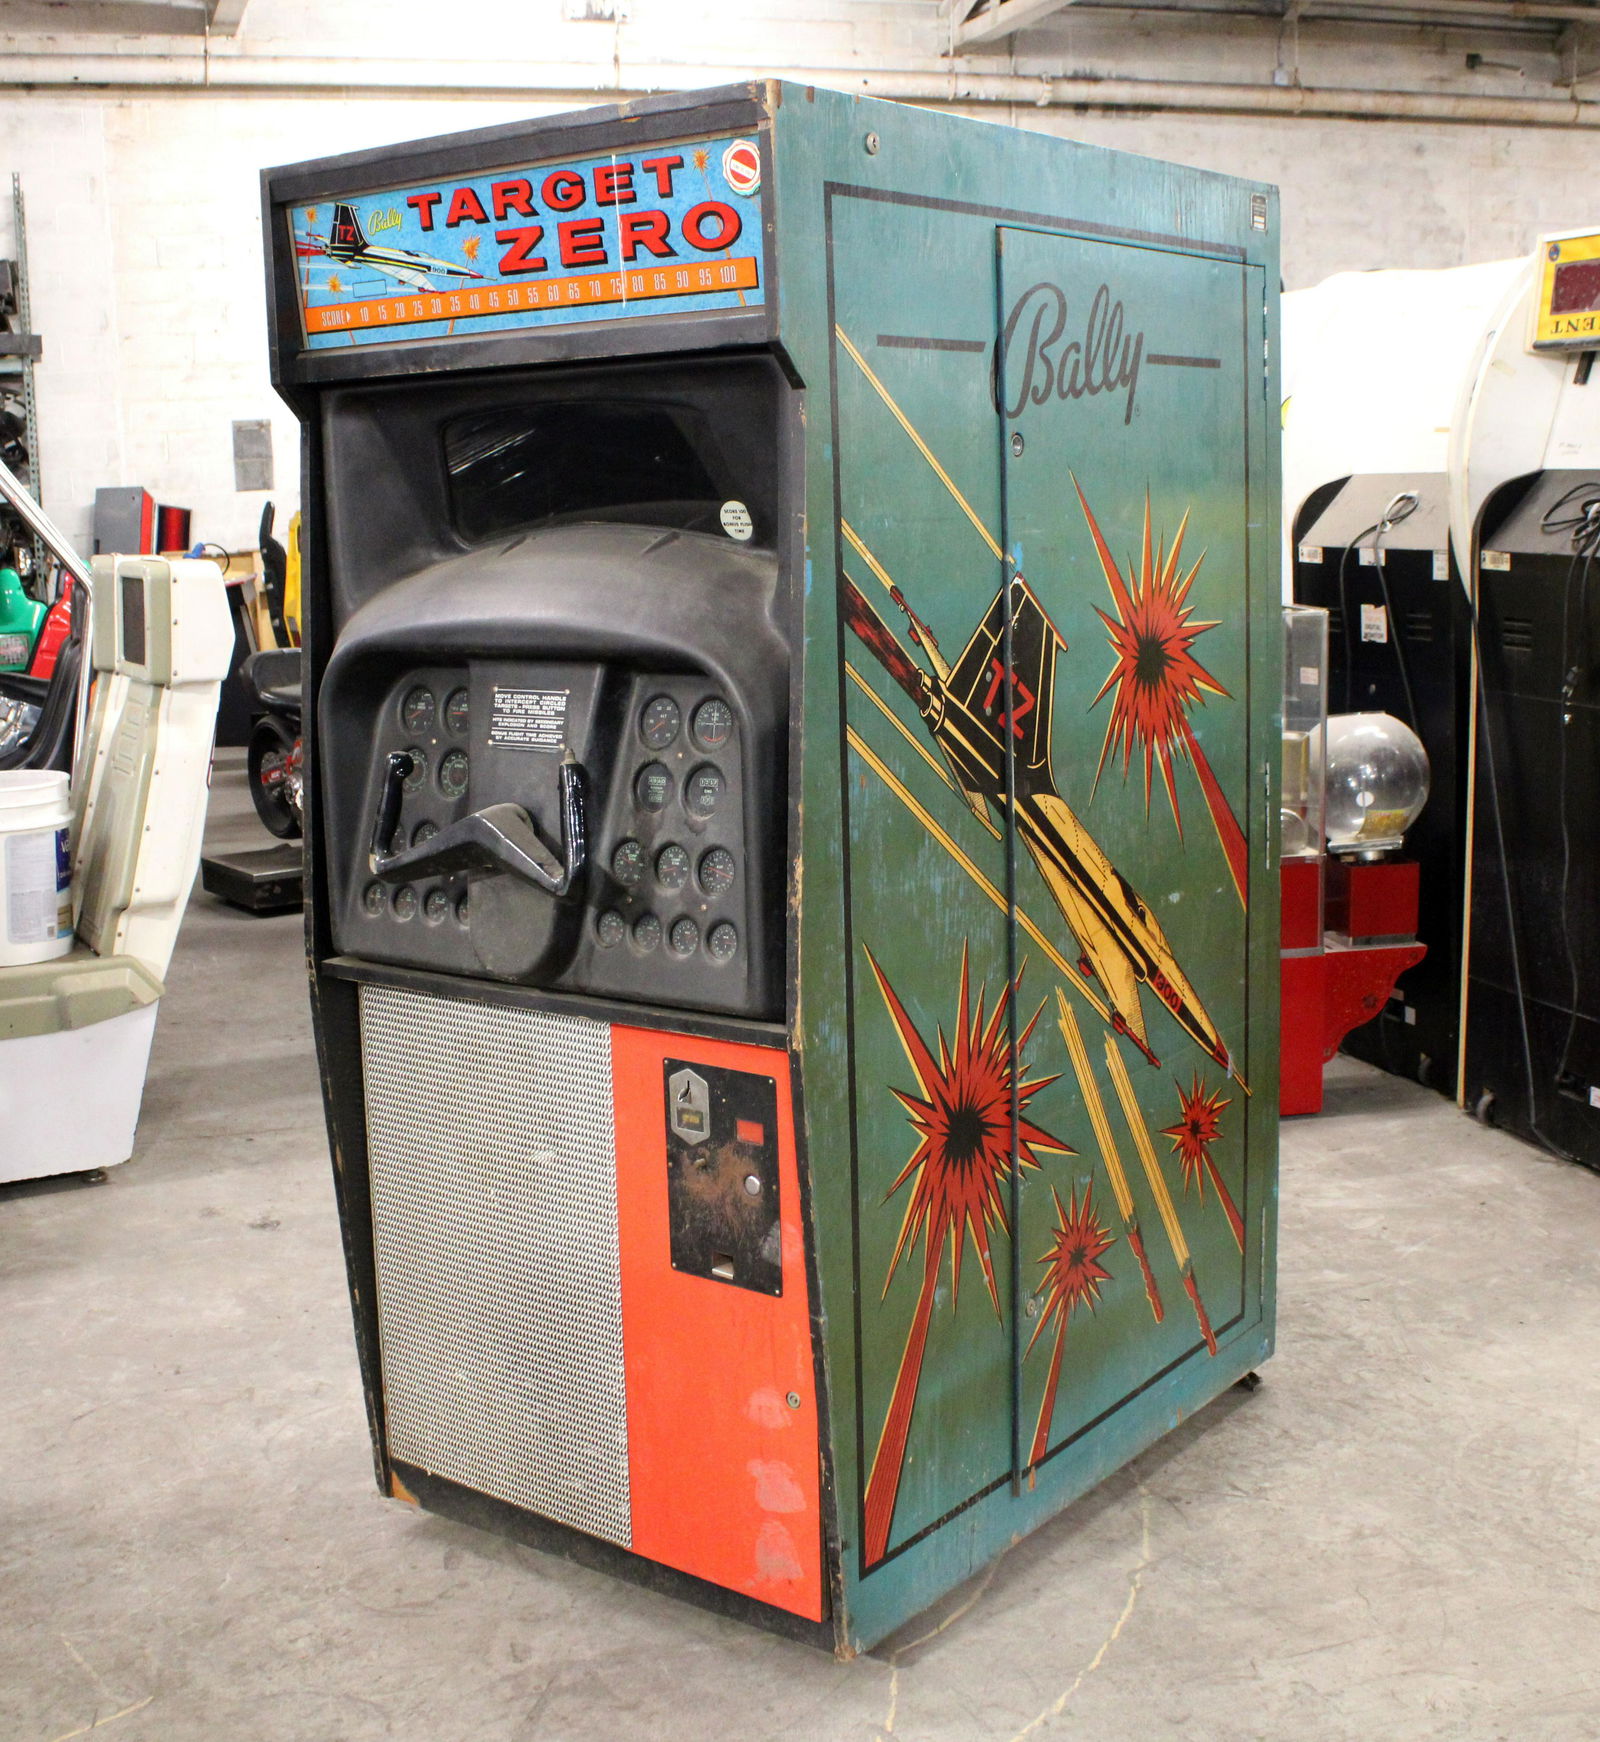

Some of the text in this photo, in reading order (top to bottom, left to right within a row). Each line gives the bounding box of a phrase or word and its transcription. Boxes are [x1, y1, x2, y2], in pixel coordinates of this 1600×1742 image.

[368, 208, 403, 236] Bally
[406, 154, 685, 232] TARGET
[338, 225, 355, 241] TZ
[495, 201, 742, 277] ZERO
[321, 265, 737, 328] SCORE 10 15 20 25 30 35 40 45 50 55 60 65 70 75 80 85 90 95 100
[990, 282, 1144, 425] Bally
[983, 657, 1035, 739] TZ
[1156, 973, 1179, 1009] 900
